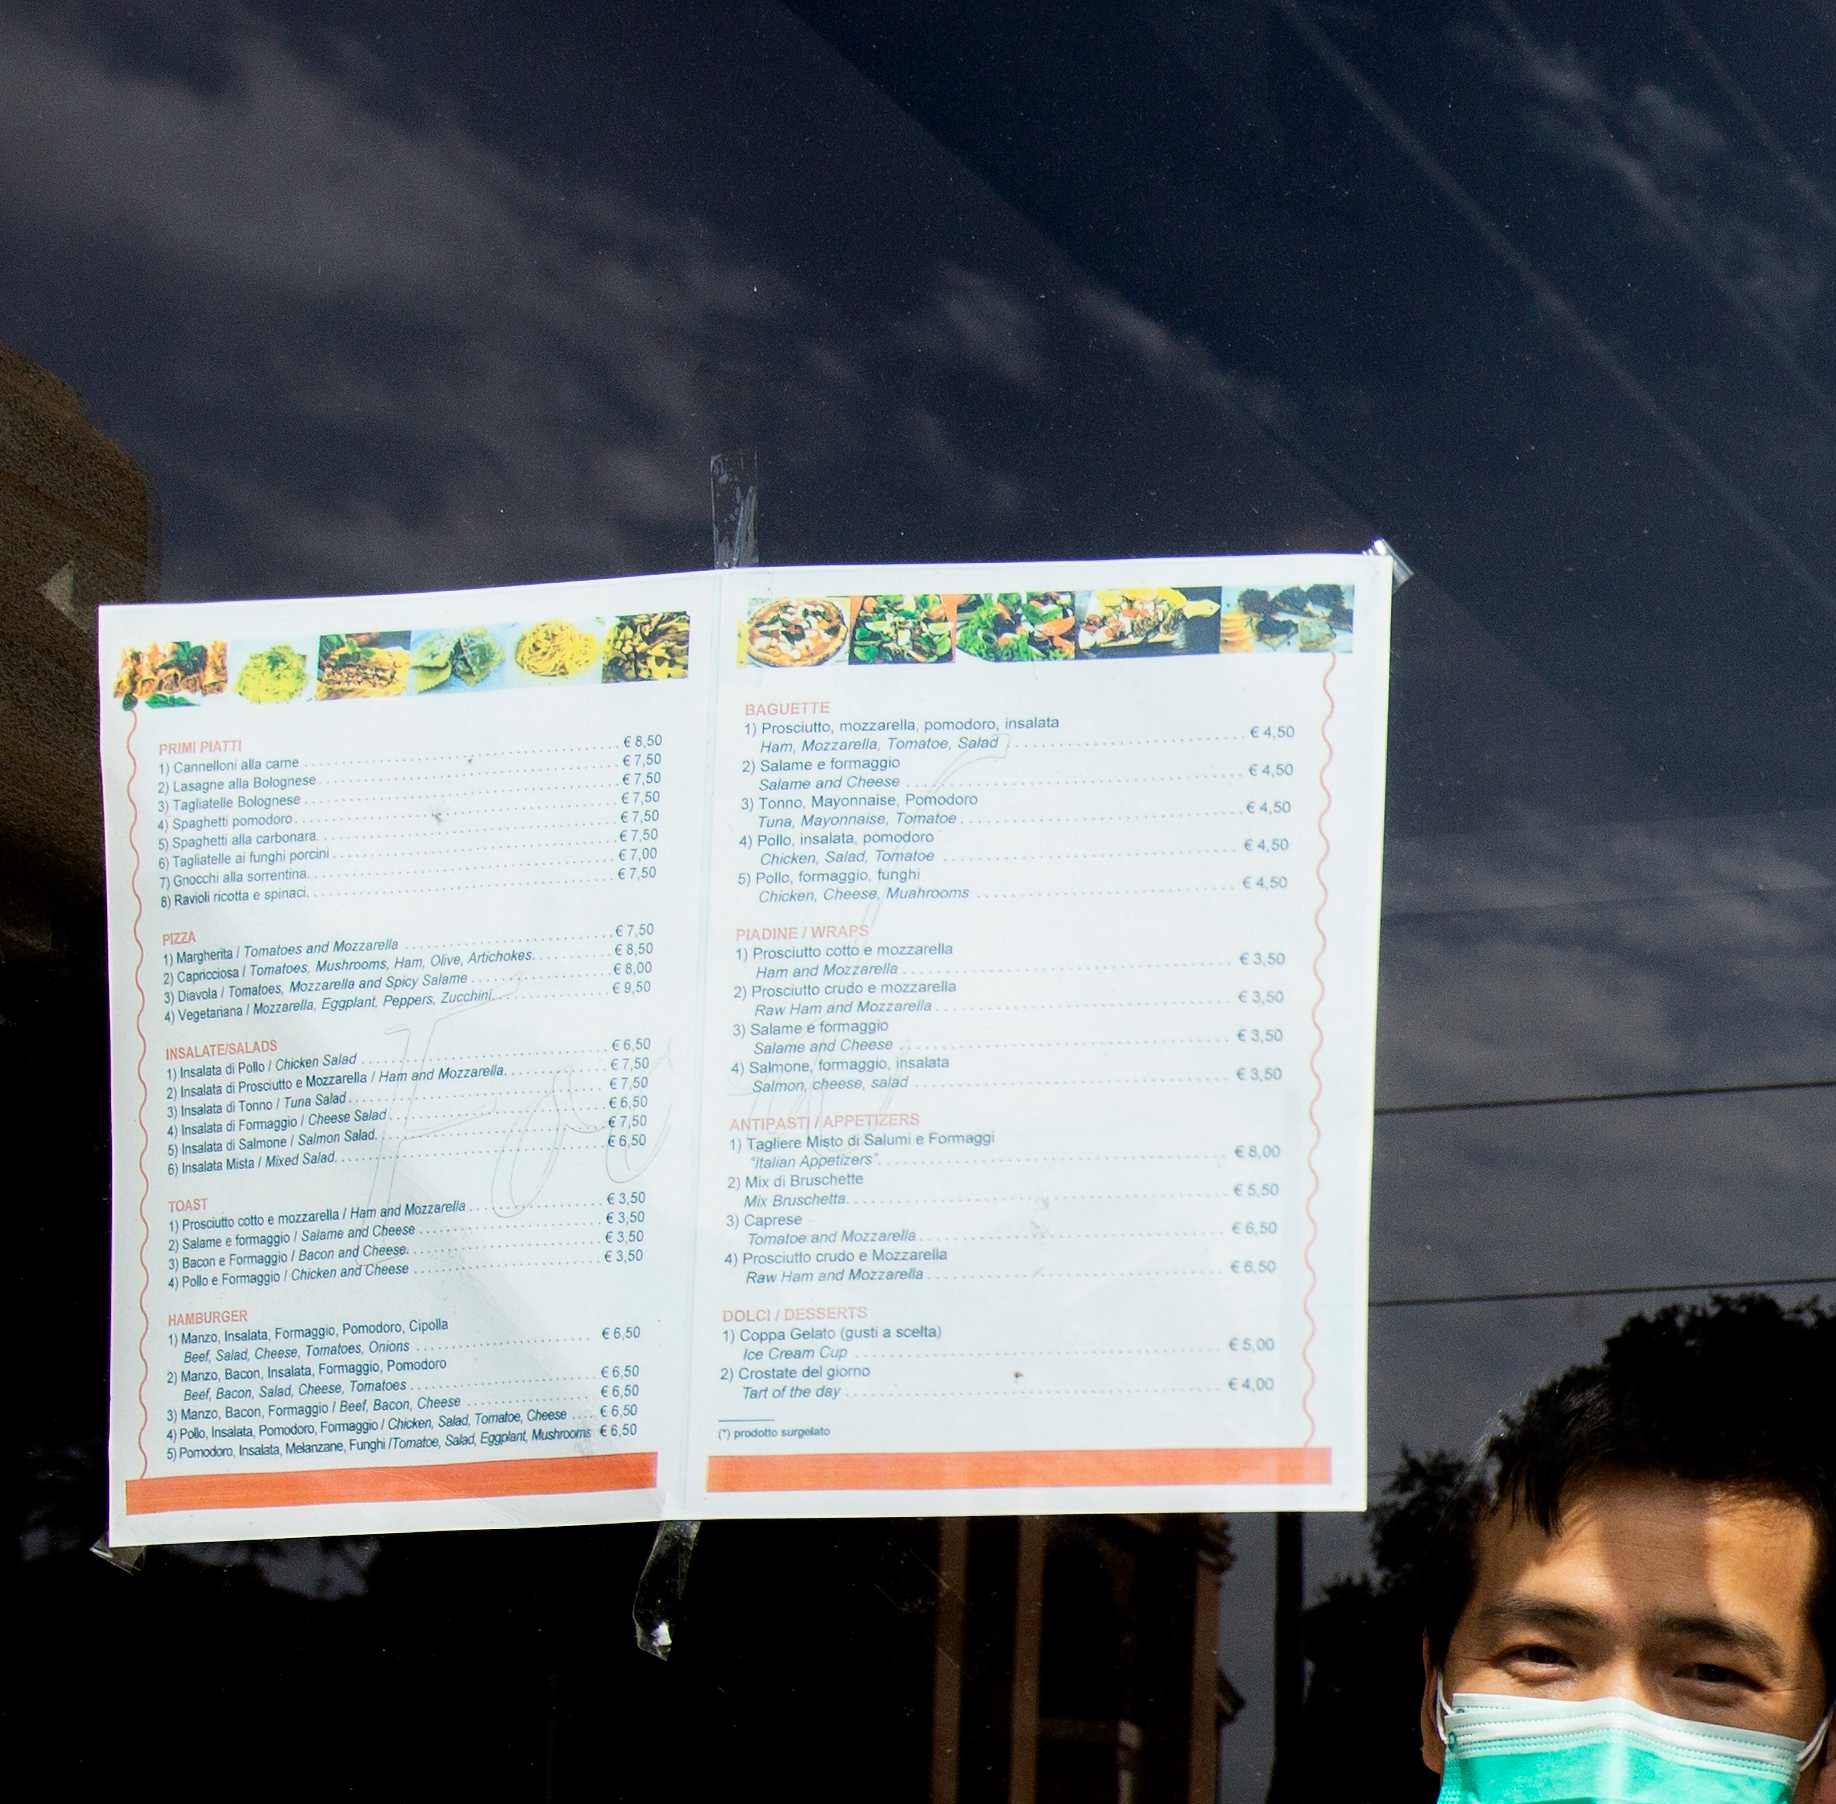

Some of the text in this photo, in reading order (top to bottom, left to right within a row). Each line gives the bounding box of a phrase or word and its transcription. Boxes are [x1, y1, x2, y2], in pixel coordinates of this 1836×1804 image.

[745, 701, 830, 719] BAGUETTE
[745, 717, 1059, 737] 1) Prosciutto, mozzarella, pomodoro, insalata
[159, 739, 241, 755] PRIMI PIATTI
[760, 725, 1295, 754] Ham, Mozzarella, Tomatoe, Salad € 4,50
[160, 734, 662, 777] 1) Cannelloni alla carne € 8,50
[742, 758, 900, 775] 2) Salame e formaggio
[158, 752, 661, 796] 2) Lasagne alla Bolognese € 7,50
[759, 763, 1294, 792] Salame and Cheese € 4,50
[158, 771, 661, 814] 3) Tagliatelle Bolognese € 7,50
[157, 790, 660, 833] 4) Spaghetti pomodoro € 7,50
[158, 809, 659, 852] 5) Spaghetti alla carbonara € 7,50
[158, 827, 658, 871] 6) Tagliatelle ai funghi porcini € 7,50
[160, 846, 657, 892] 7) Gnocchi alla sorrentina € 7,00
[161, 866, 656, 909] 8) Ravioli ricotta e spinaci € 7,50
[162, 931, 196, 946] PIZZA
[736, 926, 797, 945] PIADINE
[810, 924, 869, 942] WRAPS
[166, 1040, 280, 1060] INSALATE/SALADS
[730, 1117, 809, 1133] ANTIPASTI
[823, 1113, 920, 1131] APPETIZERS
[168, 1198, 208, 1215] TOAST
[726, 1214, 802, 1230] 3) Caprese
[748, 1220, 1279, 1246] Tomatoe and Mozzarella € 6,50
[168, 1310, 248, 1327] HAMBURGER
[723, 1308, 771, 1325] DOLCI
[784, 1306, 868, 1321] DESSERTS
[169, 1318, 448, 1347] 1) Manzo, Insalata, Formaggio, Pomodoro, Cipolla
[723, 1325, 941, 1344] 1) Coppa Gelato (gusti a scelta)
[184, 1326, 640, 1364] Beef, Salad, Cheese, Tomatoes, Onions € 6,50
[743, 1337, 1275, 1361] Ice Cream Cup € 5,00
[720, 1365, 871, 1383] 2) Crostate del giorno
[743, 1376, 1274, 1401] Tart of the day € 4,00
[734, 1428, 778, 1439] prodotto
[781, 1427, 830, 1438] surgelato
